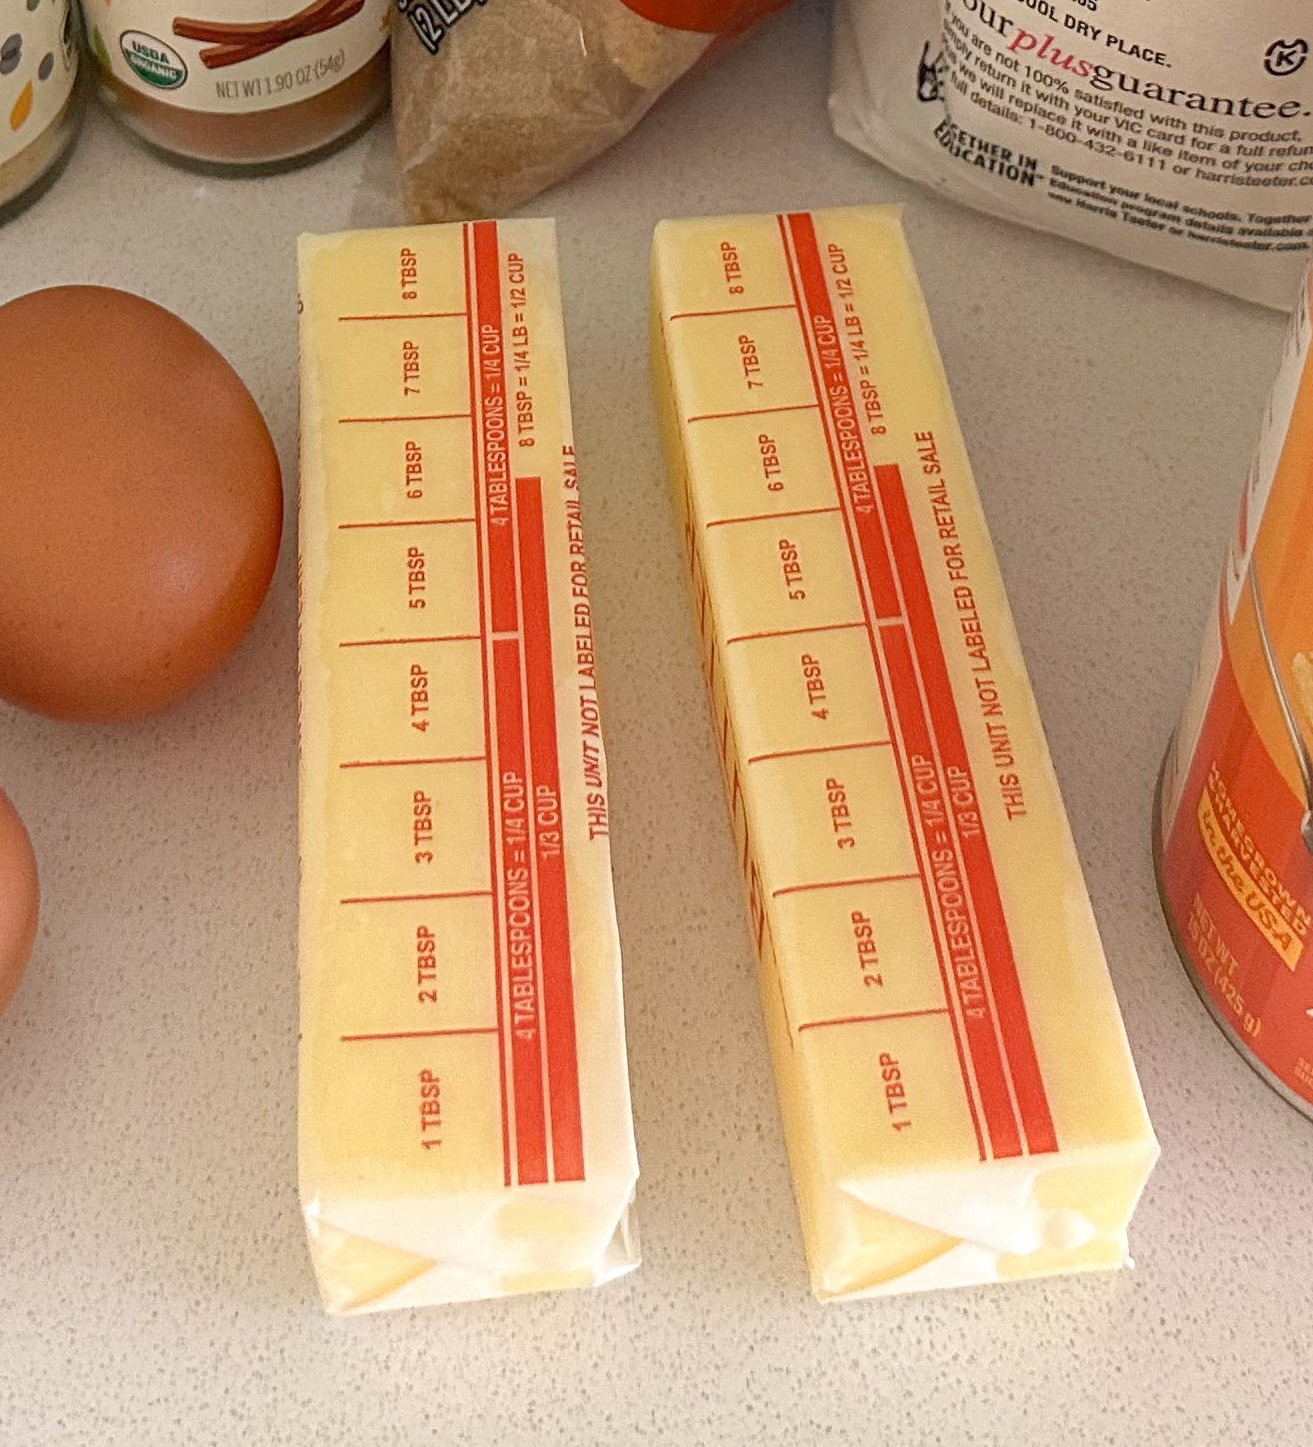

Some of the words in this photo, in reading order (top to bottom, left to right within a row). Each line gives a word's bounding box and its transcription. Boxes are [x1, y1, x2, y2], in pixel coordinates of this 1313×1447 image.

[131, 40, 171, 65] USDA
[1064, 14, 1102, 41] DRY
[1107, 34, 1173, 68] PLACE.
[215, 82, 239, 99] NET
[243, 80, 263, 98] WT
[265, 73, 294, 94] 1.90
[295, 65, 312, 86] OZ
[1025, 65, 1069, 94] 100%
[1075, 88, 1145, 121] satisfied
[1030, 116, 1166, 171] 1-800-432-6111
[739, 335, 760, 376] TBSP
[747, 376, 764, 391] 7
[405, 441, 423, 483] TBSP
[484, 396, 512, 514] TABLESPOONS
[913, 429, 943, 475] SALE
[407, 486, 424, 499] 6
[927, 478, 959, 541] RETAIL
[779, 538, 804, 585] TBSP
[943, 540, 966, 582] FOR
[789, 588, 806, 601] 5
[949, 577, 992, 674] LABELED
[802, 653, 827, 705] TBSP
[975, 673, 1004, 719] NOT
[811, 707, 829, 721] 4
[985, 720, 1014, 769] UNIT
[413, 789, 433, 846] TBSP
[536, 785, 559, 828] CUP
[995, 773, 1027, 821] THIS
[415, 850, 434, 865] 3
[540, 830, 562, 859] 1/3
[1216, 842, 1243, 892] the
[1244, 890, 1293, 953] USA
[932, 849, 986, 1008] TABLESPOONS
[420, 1069, 442, 1132] TBSP
[422, 1139, 442, 1150] 1
